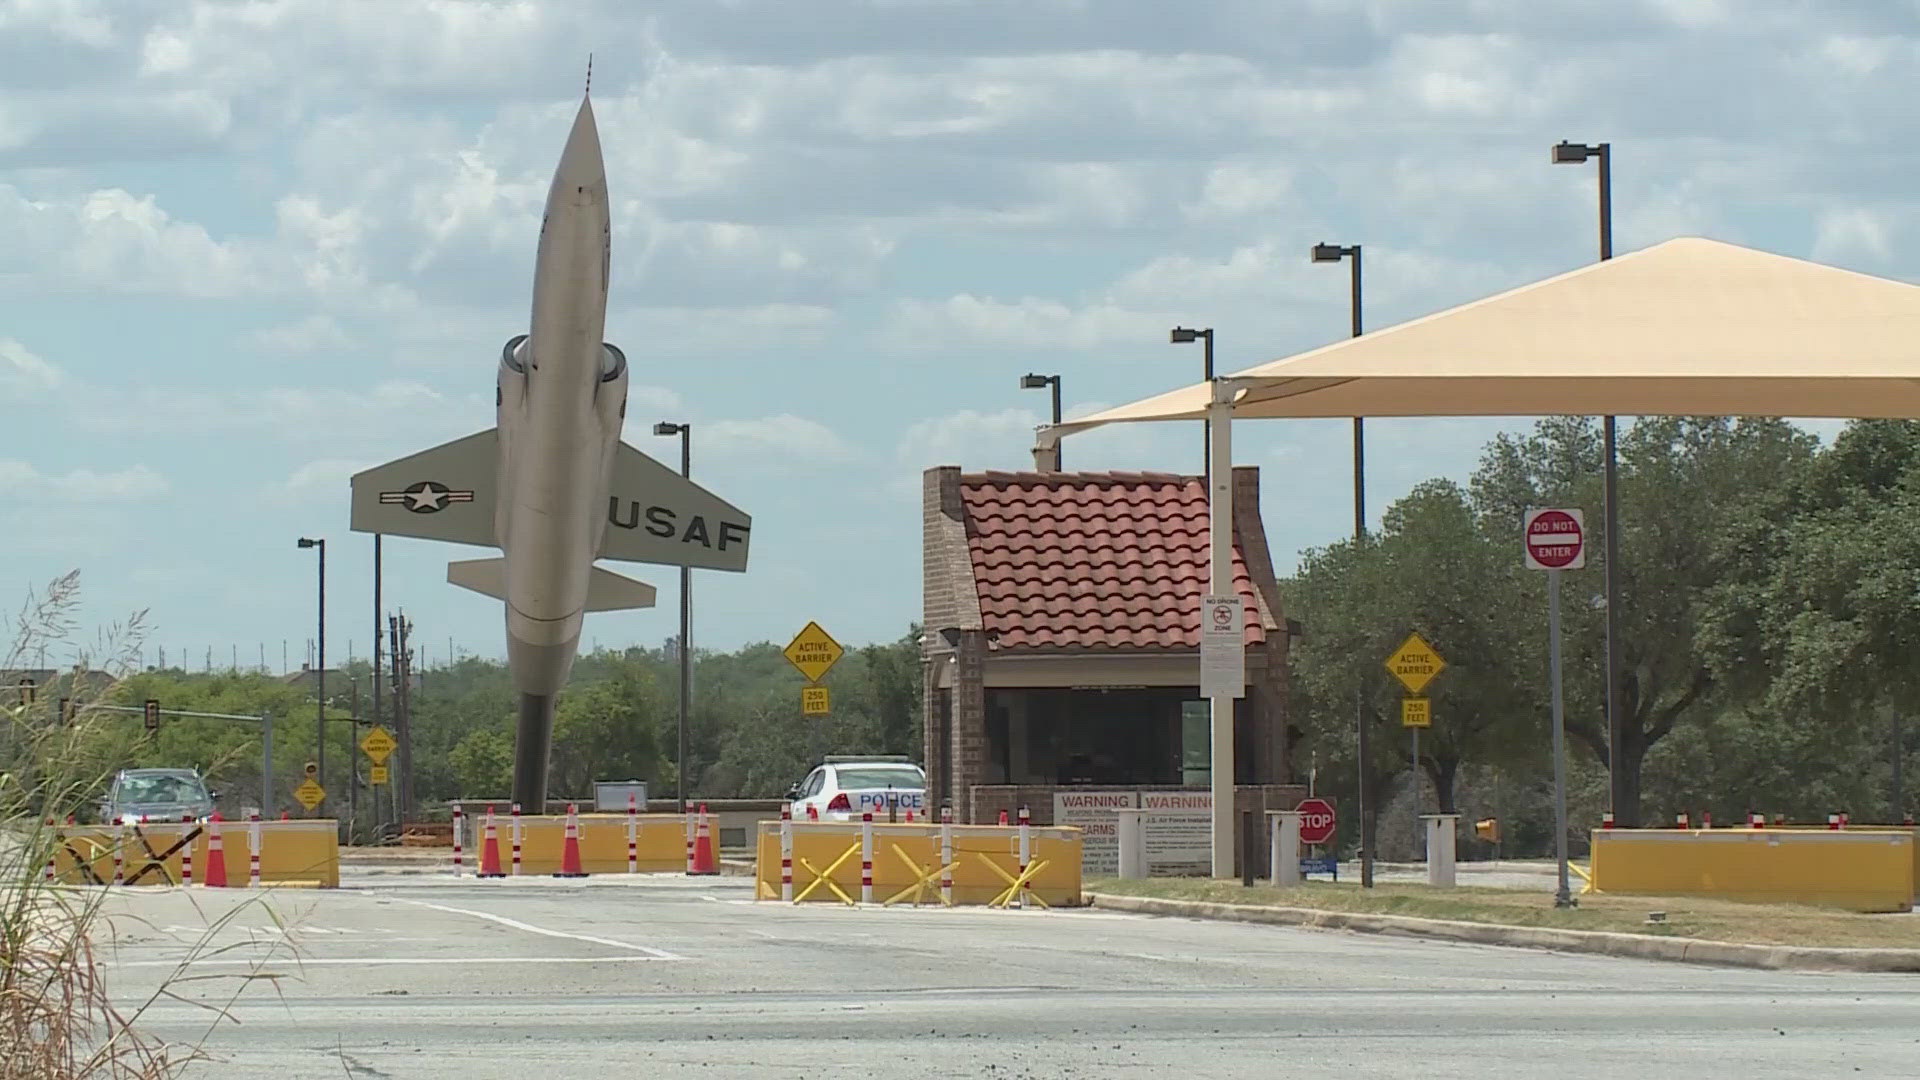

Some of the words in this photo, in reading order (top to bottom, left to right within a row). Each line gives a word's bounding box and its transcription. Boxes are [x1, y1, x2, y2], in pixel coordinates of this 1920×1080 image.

[608, 496, 750, 551] USAF
[1534, 522, 1549, 532] DO
[1552, 521, 1574, 531] NOT
[1539, 547, 1571, 557] ENTER
[798, 642, 828, 651] ACTIVE
[795, 653, 832, 663] BARRIER
[1400, 654, 1429, 663] ACTIVE
[1397, 666, 1434, 674] BARRIER
[808, 691, 823, 700] 250
[806, 701, 825, 710] FEET
[1408, 703, 1424, 712] 250
[1407, 713, 1425, 721] FEET
[860, 794, 922, 808] POLICE
[1062, 795, 1129, 807] WARNING
[1146, 797, 1212, 808] WARNIN
[1299, 814, 1332, 829] STOP
[1081, 824, 1115, 835] EARMS
